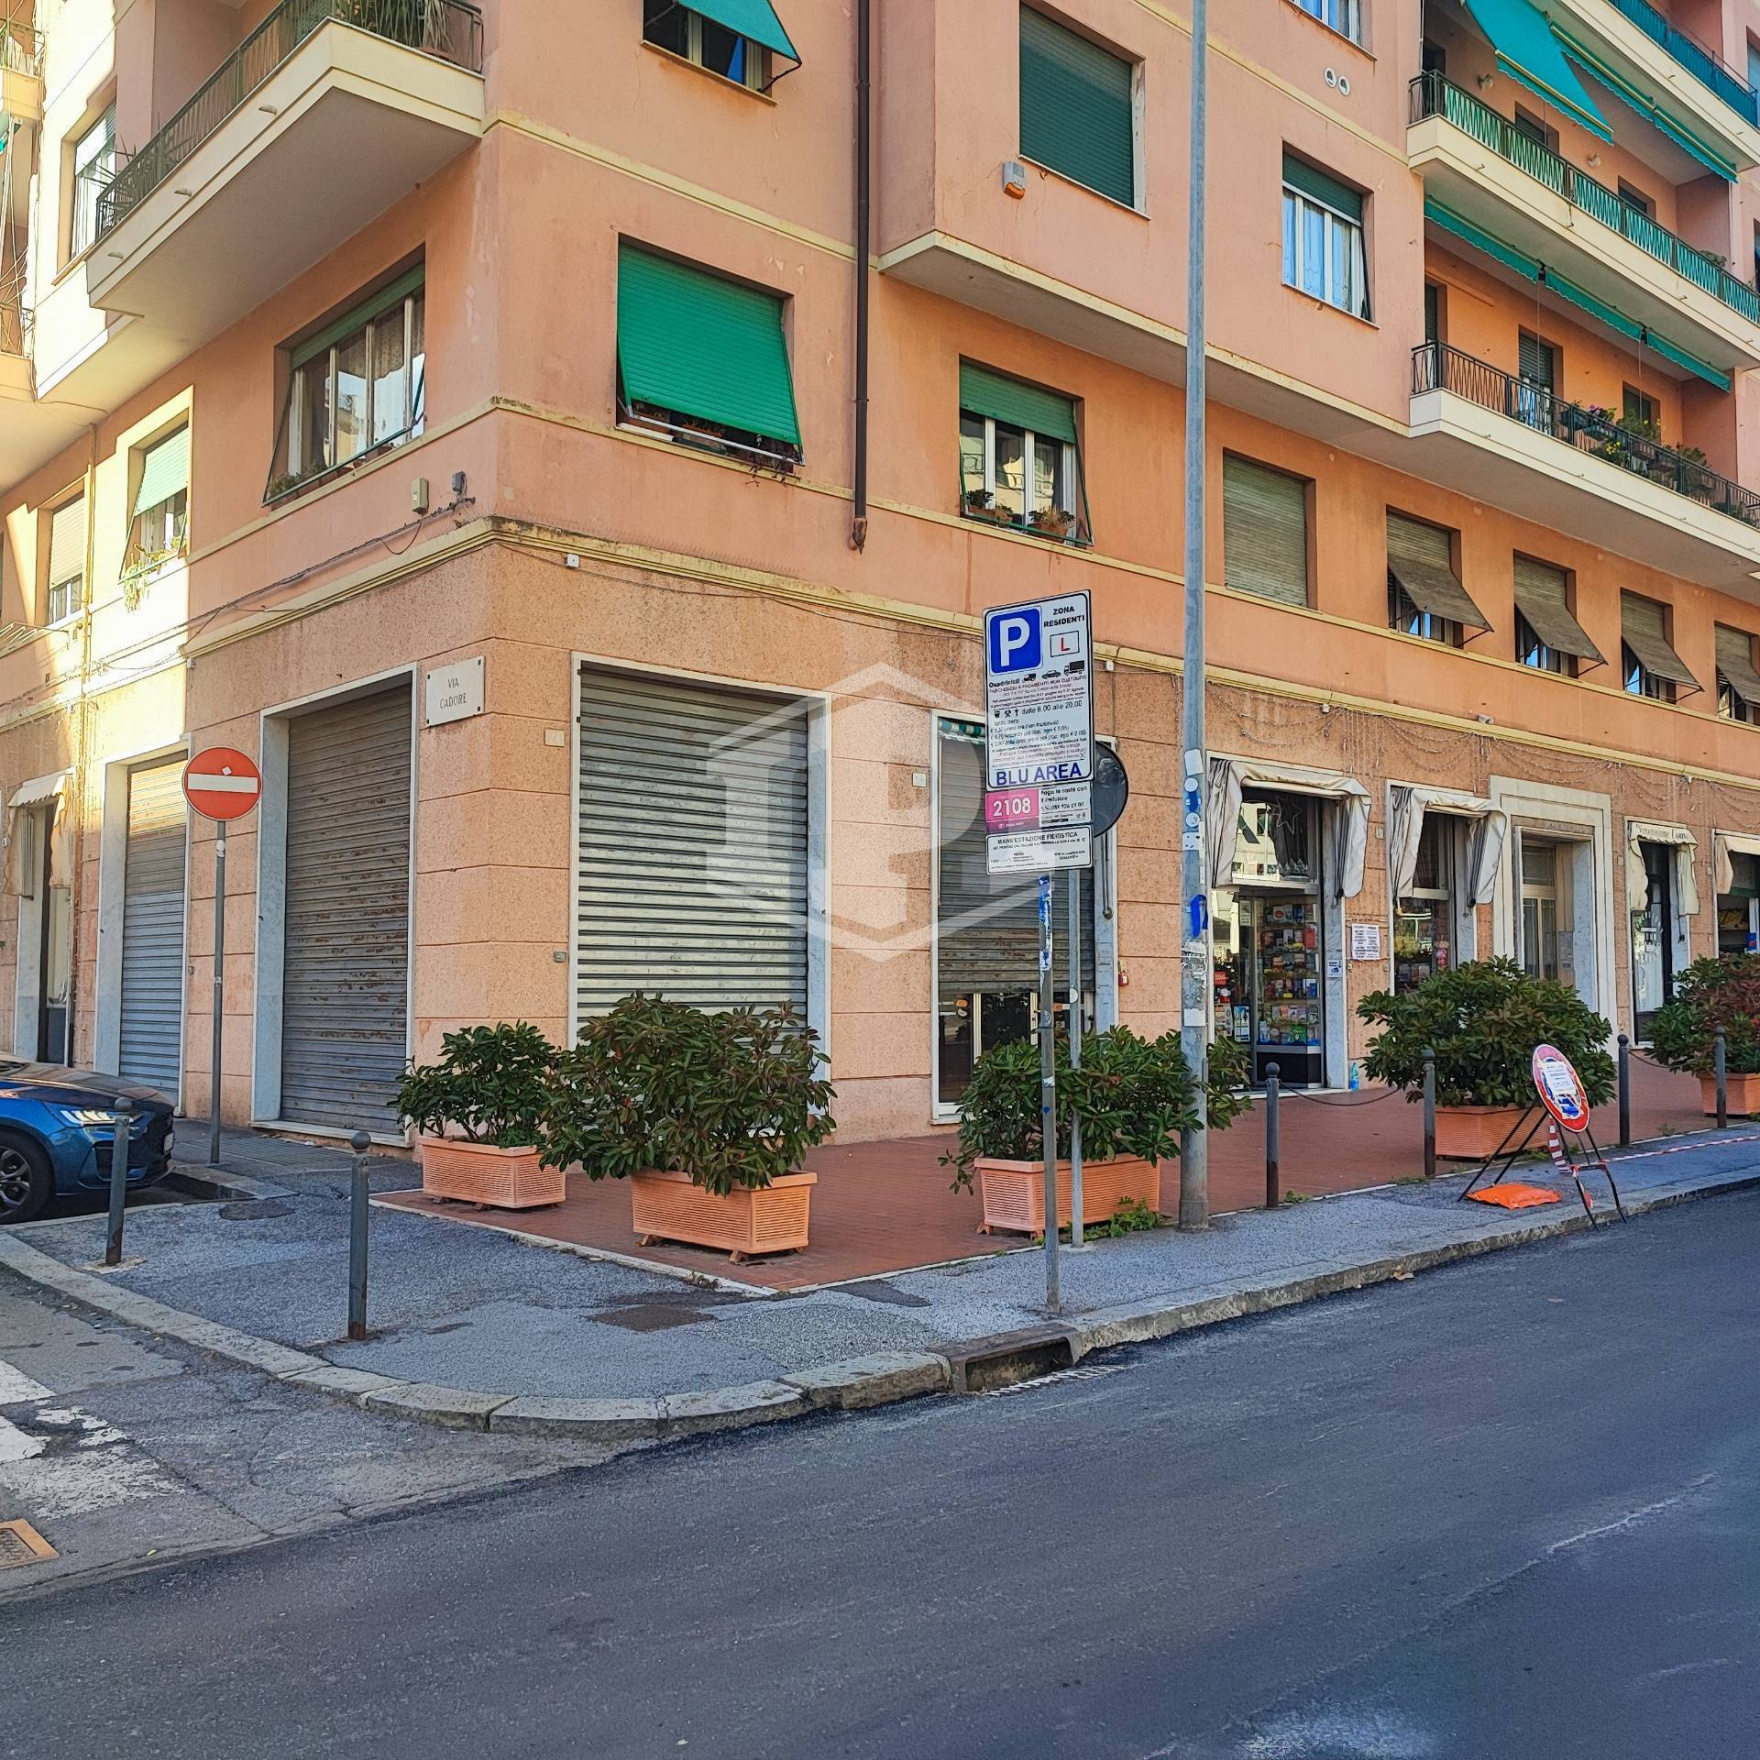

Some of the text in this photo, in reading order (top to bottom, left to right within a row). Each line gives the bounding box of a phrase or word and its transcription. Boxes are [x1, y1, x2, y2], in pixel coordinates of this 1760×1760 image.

[1053, 606, 1075, 615] ZONA
[1044, 615, 1085, 628] RESIDENTI
[1000, 617, 1030, 667] P
[1061, 637, 1070, 651] L
[448, 678, 459, 688] VIA
[440, 693, 467, 709] CADORE
[996, 762, 1082, 786] BLU AREA
[993, 797, 1031, 817] 2108
